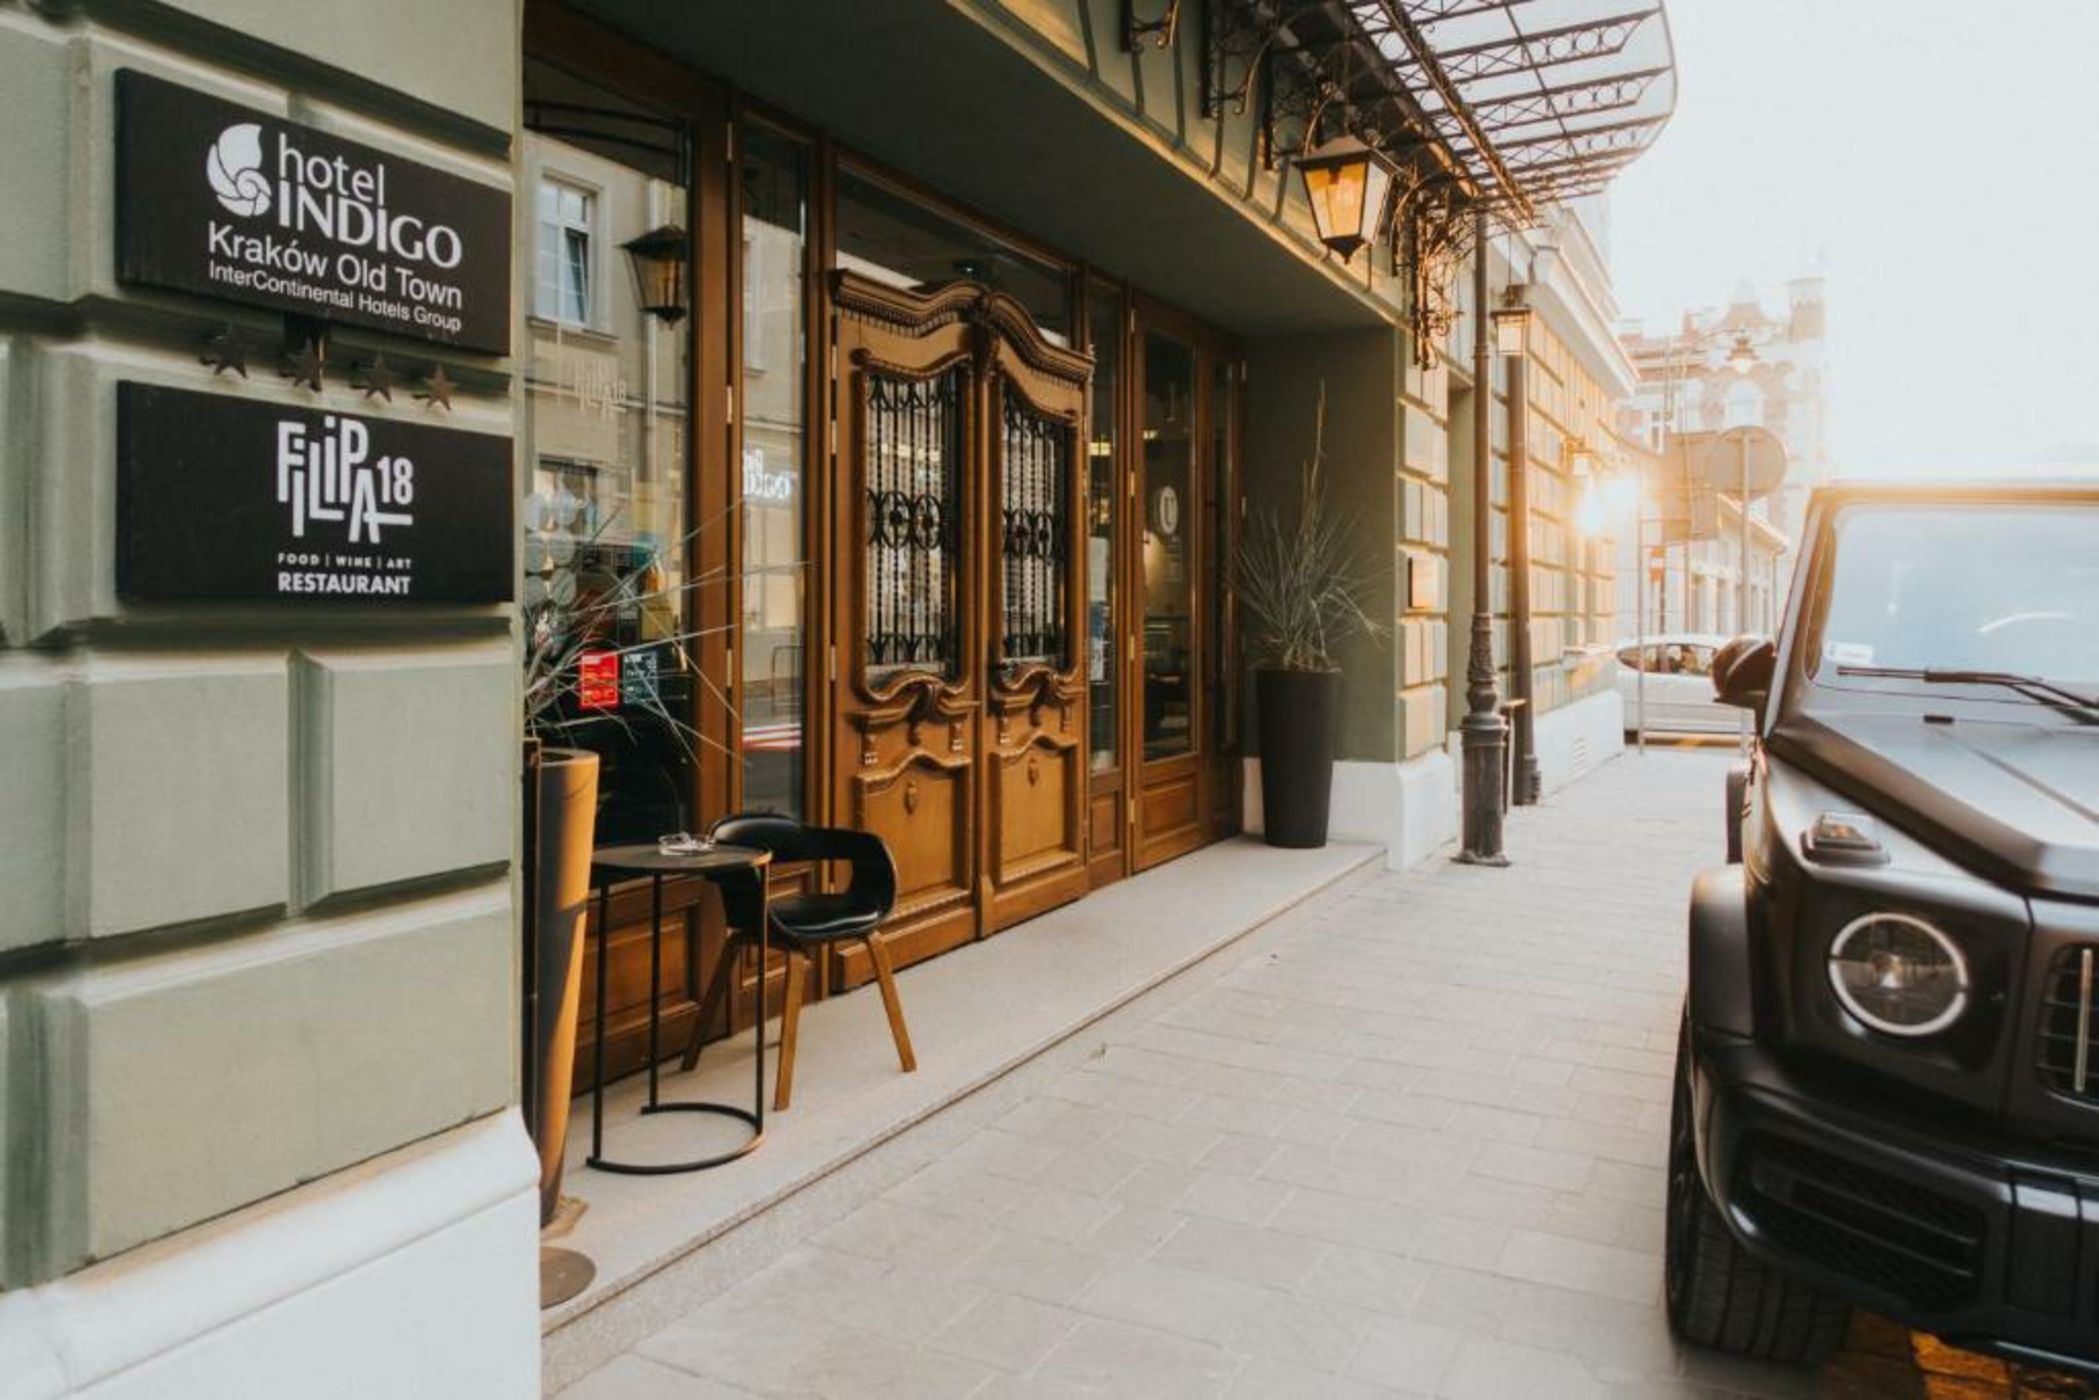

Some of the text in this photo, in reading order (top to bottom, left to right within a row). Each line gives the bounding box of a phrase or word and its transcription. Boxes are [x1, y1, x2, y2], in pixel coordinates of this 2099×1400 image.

[279, 133, 384, 206] hotel
[279, 180, 463, 268] INDIGO
[208, 221, 463, 310] Kraków Old Town
[208, 260, 462, 332] InterContinental Hotels Group
[377, 456, 414, 504] 18
[277, 553, 411, 569] FOOD WINE ART
[278, 573, 411, 594] RESTAURANT
